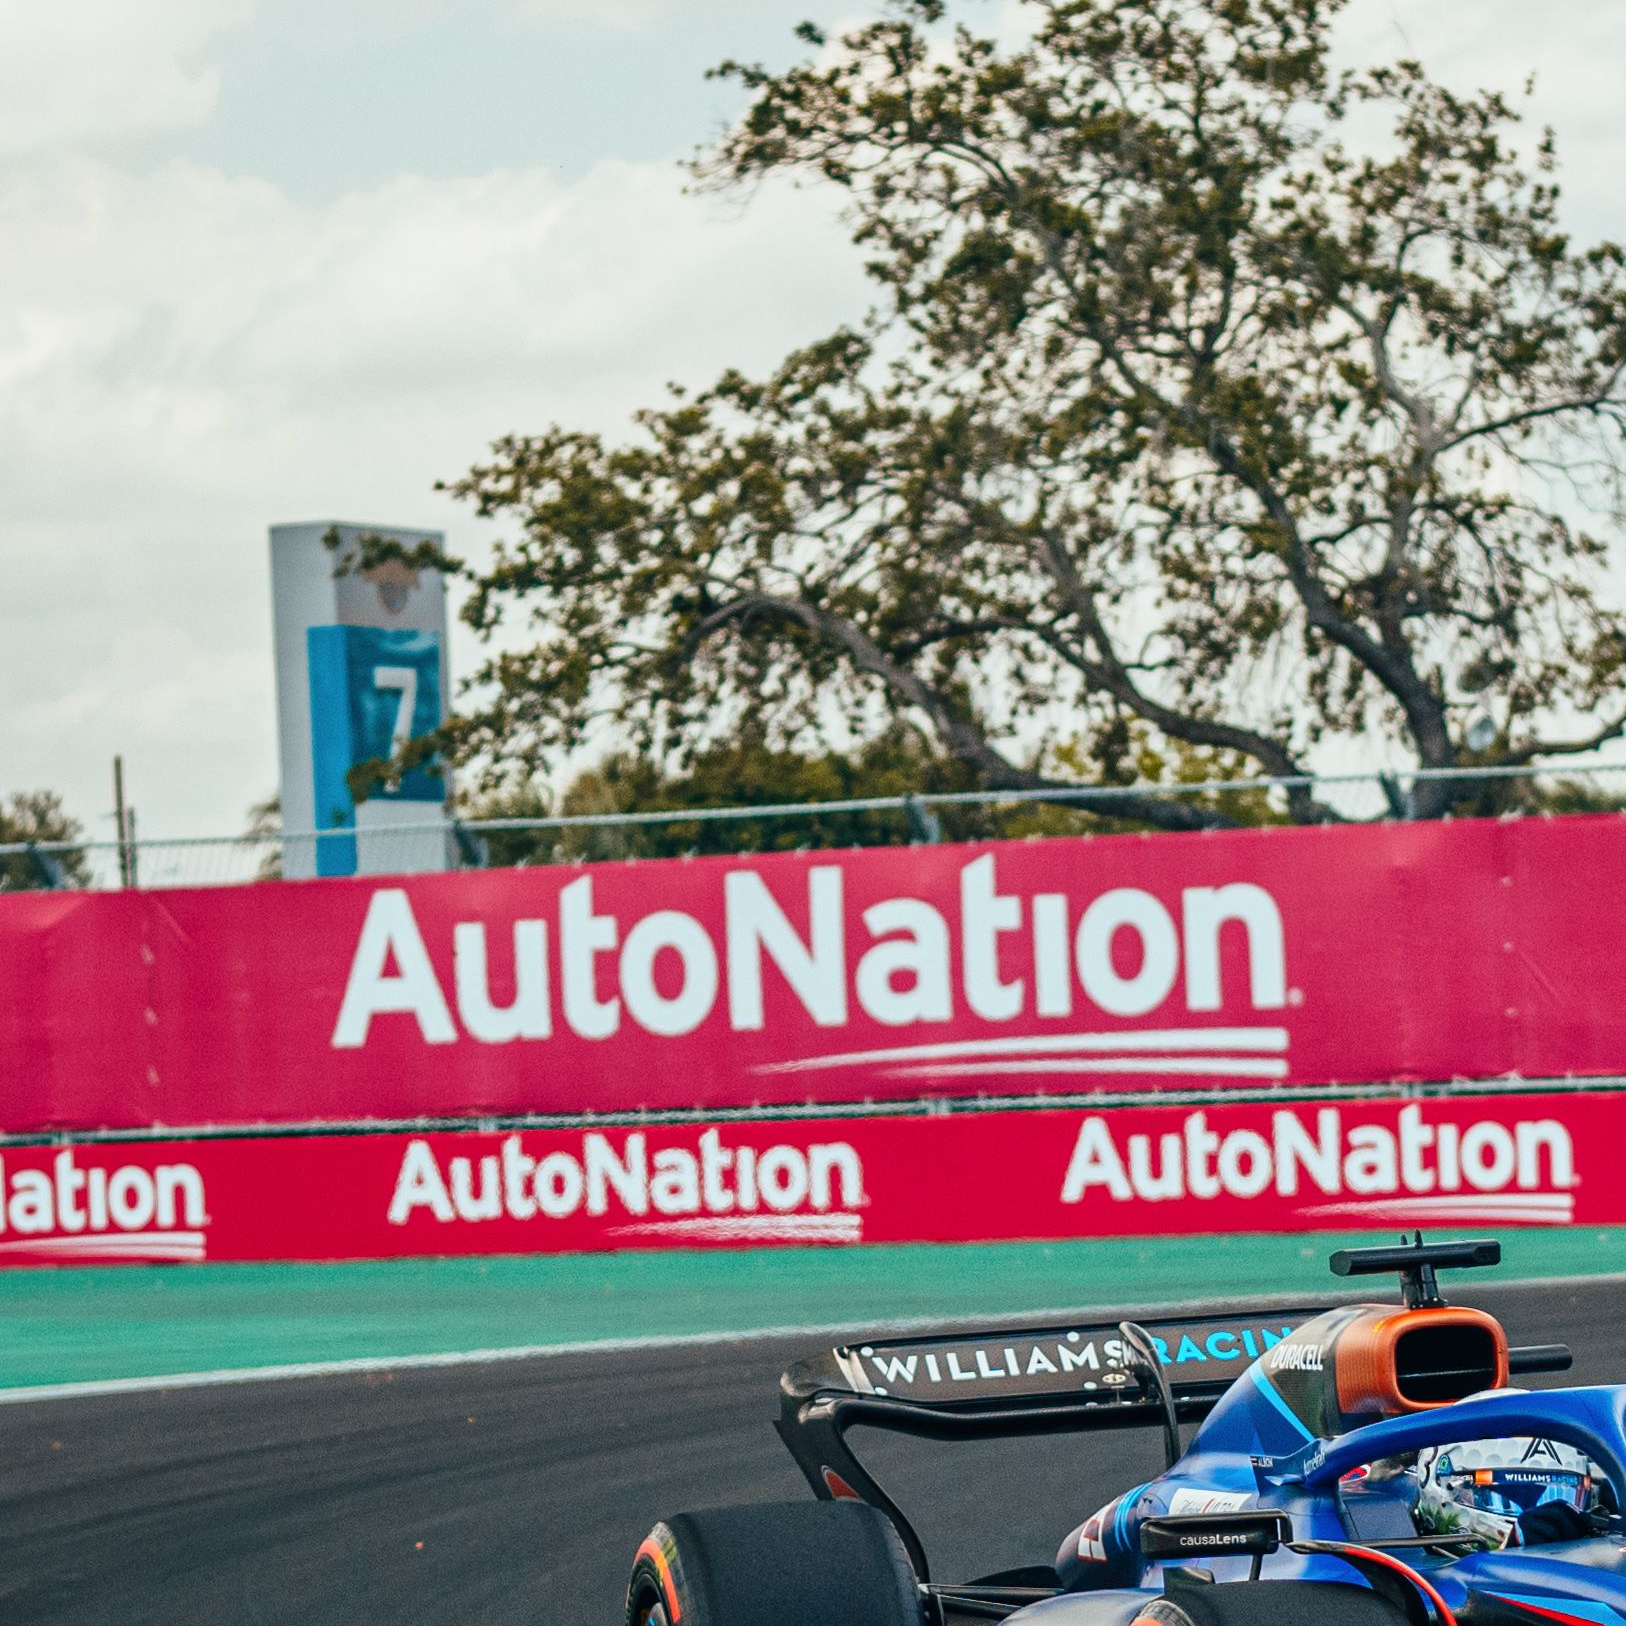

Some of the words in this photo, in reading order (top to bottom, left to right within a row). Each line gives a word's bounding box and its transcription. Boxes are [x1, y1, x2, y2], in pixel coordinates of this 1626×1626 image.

[373, 665, 417, 792] 7
[332, 853, 1288, 1048] AutoNation
[0, 1150, 206, 1232] ation
[388, 1128, 863, 1225] AutoNation
[1060, 1103, 1573, 1204] AutoNation
[872, 1340, 1122, 1383] WILLIAMS
[1269, 1344, 1323, 1371] DURACELL
[1504, 1473, 1551, 1483] WILLIAMS
[1179, 1532, 1248, 1546] causaLens
